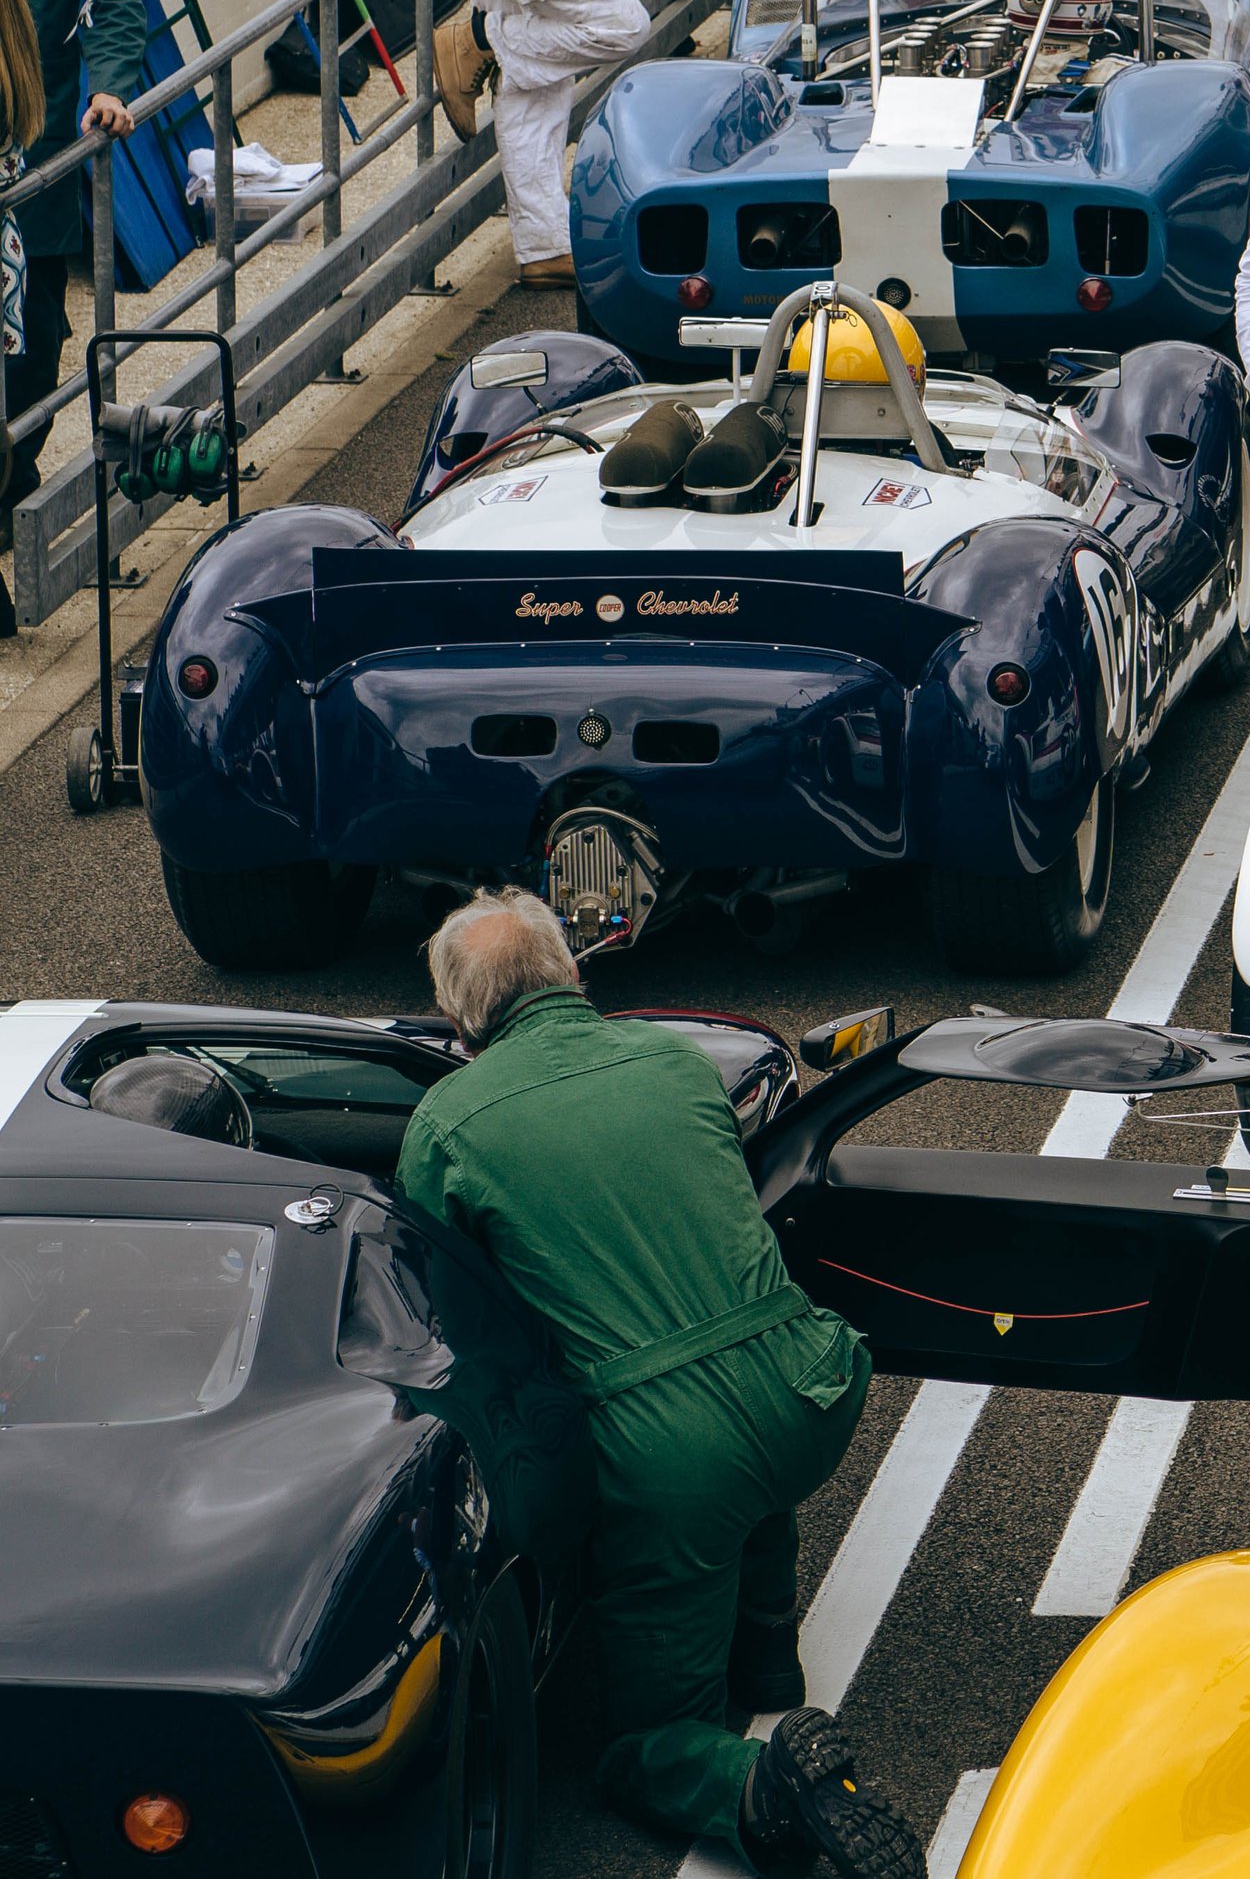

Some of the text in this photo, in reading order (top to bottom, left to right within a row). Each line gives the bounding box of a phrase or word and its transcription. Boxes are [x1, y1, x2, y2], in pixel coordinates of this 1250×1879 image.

[515, 590, 739, 625] Super COOPER Chevrolet
